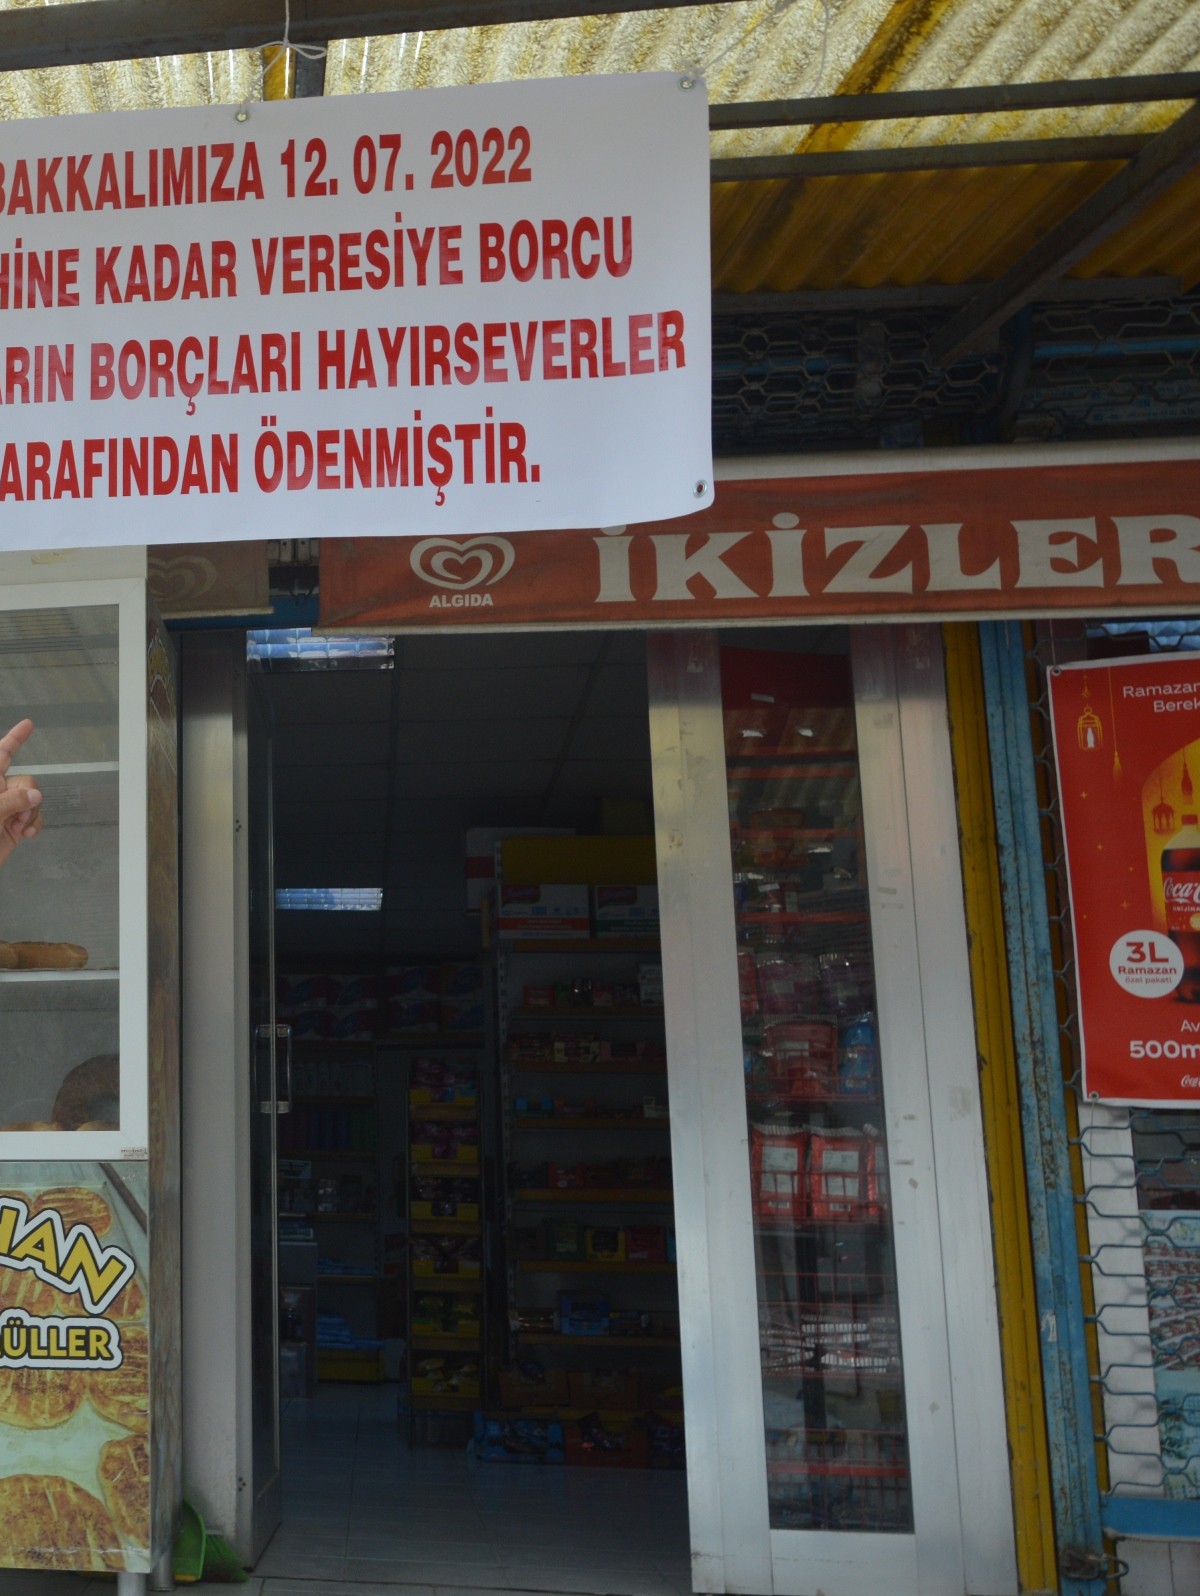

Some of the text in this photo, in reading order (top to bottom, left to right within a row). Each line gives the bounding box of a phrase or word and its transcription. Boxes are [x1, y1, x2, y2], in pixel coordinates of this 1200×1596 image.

[280, 139, 340, 199] 12.
[353, 134, 415, 192] 07.
[431, 126, 532, 187] 2022
[95, 240, 238, 305] KADAR
[252, 211, 464, 297] VERESİYE
[479, 215, 633, 284] BORCU
[89, 331, 302, 416] BORÇLARI
[317, 309, 687, 391] HAYIRSEVERLER
[253, 405, 542, 507] ÖDENMİŞTİR.
[593, 511, 1200, 602] İKİZLER
[429, 593, 494, 608] ALGIDA
[1118, 966, 1177, 975] Ramazan
[1125, 976, 1143, 984] özel
[1126, 941, 1169, 963] 3L
